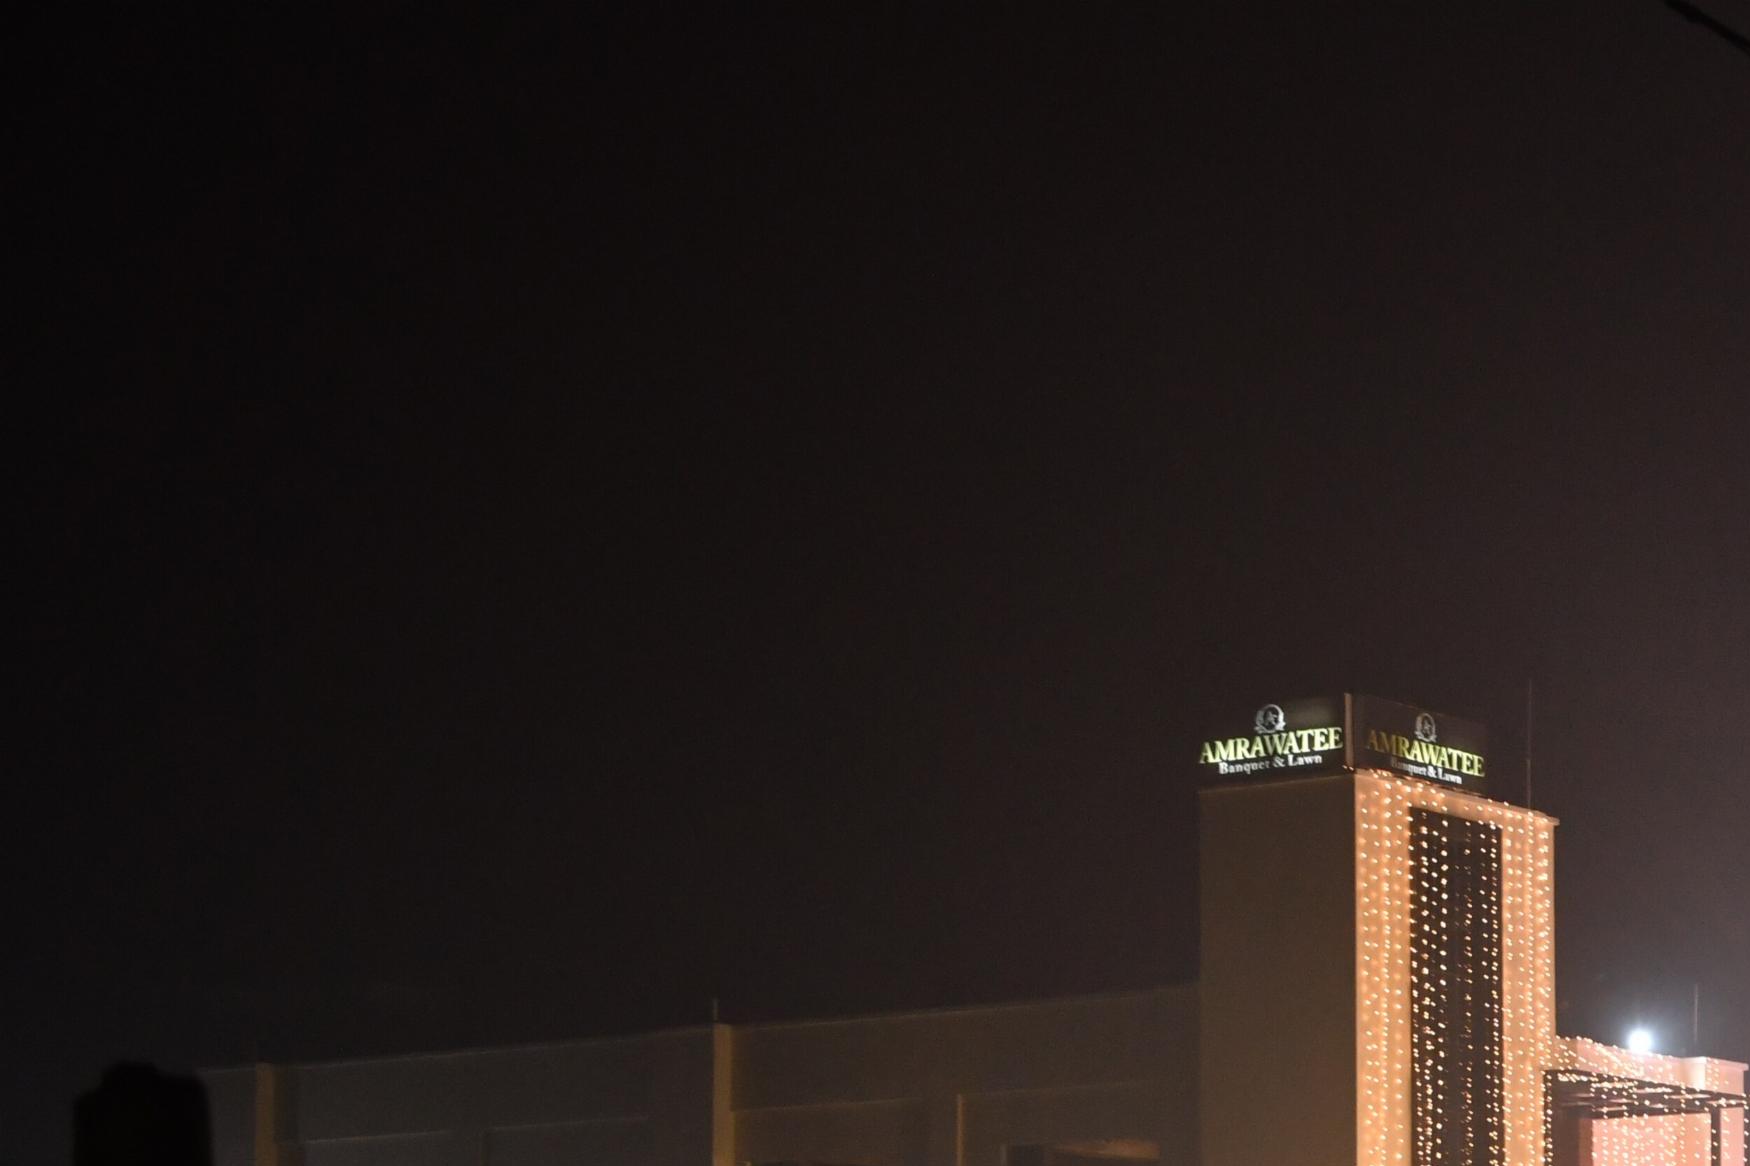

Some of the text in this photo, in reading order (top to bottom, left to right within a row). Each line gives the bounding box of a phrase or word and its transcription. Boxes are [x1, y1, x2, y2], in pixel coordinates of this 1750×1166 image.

[1200, 727, 1343, 764] AMRAWATEE
[1219, 753, 1323, 775] Banquet & Lawn
[1367, 729, 1486, 777] AMRAWATEE
